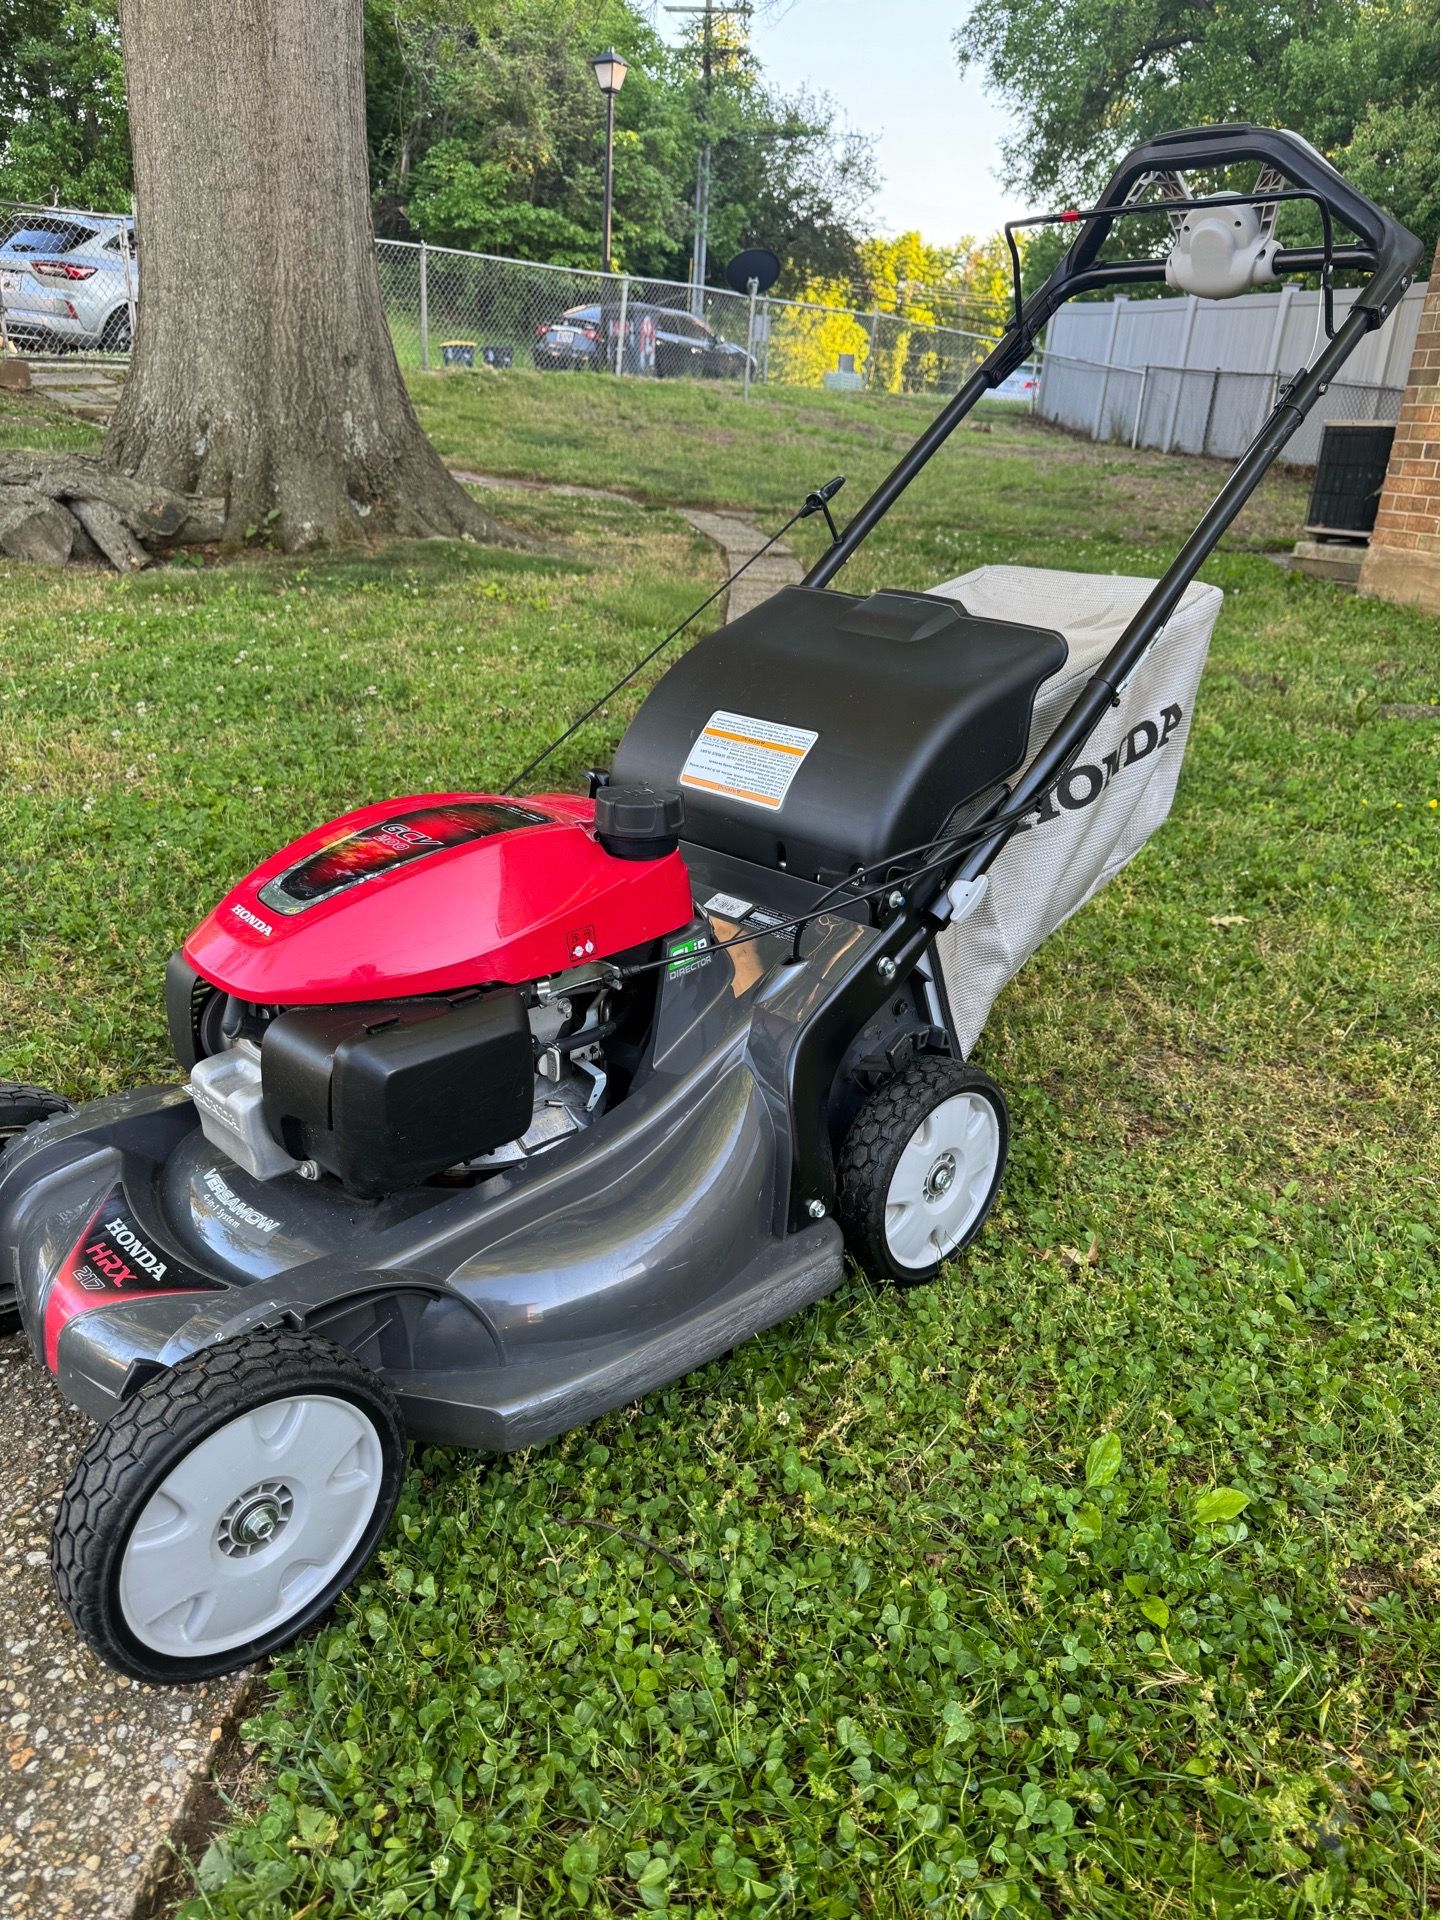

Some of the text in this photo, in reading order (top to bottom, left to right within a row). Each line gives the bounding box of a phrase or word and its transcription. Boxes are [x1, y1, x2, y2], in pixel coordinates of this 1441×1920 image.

[373, 834, 410, 851] 200
[381, 823, 444, 845] GCV
[231, 904, 273, 937] HONDA
[669, 955, 712, 981] DIRECTOR
[203, 1168, 281, 1233] VERSAMOW
[203, 1193, 241, 1229] 4-in-1 System
[85, 1241, 139, 1288] HRX
[105, 1218, 168, 1282] HONDA
[72, 1265, 106, 1291] 217
[215, 1332, 225, 1342] 2
